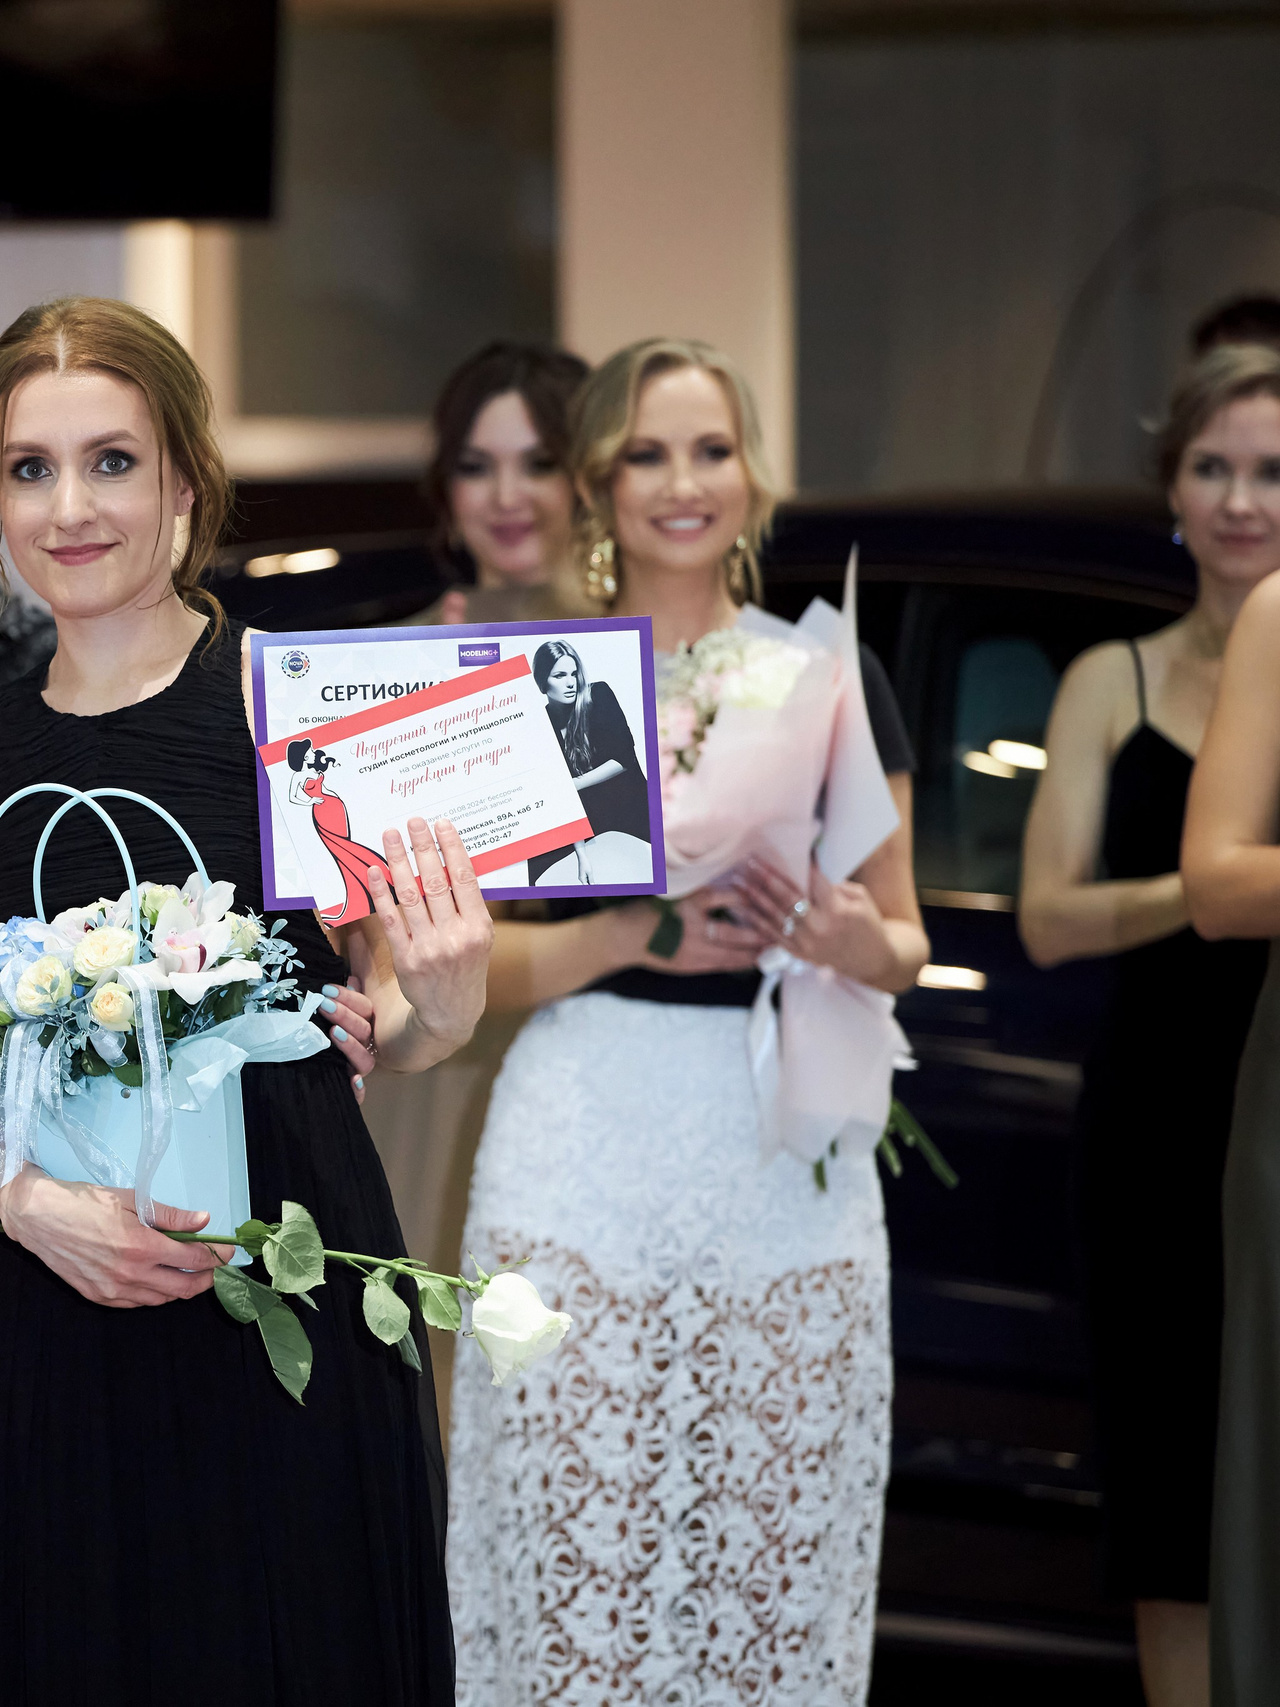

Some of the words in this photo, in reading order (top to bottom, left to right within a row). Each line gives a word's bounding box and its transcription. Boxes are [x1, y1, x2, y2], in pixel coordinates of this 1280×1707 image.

[321, 681, 444, 702] СЕРТИФИ
[298, 716, 310, 724] ОБ
[434, 694, 517, 735] сертификат
[358, 759, 389, 774] студии
[390, 738, 450, 763] косметологии
[458, 711, 524, 738] нутрициологии
[399, 766, 410, 774] на
[411, 752, 450, 770] оказание
[451, 742, 480, 757] услуги
[481, 737, 493, 746] по
[390, 765, 456, 797] коррекции
[487, 786, 523, 802] бессрочно
[489, 797, 513, 809] записи
[458, 819, 496, 835] азанская,
[534, 800, 544, 809] 27
[489, 821, 520, 834] WhatsApp
[465, 831, 512, 851] 9-134-02-47
